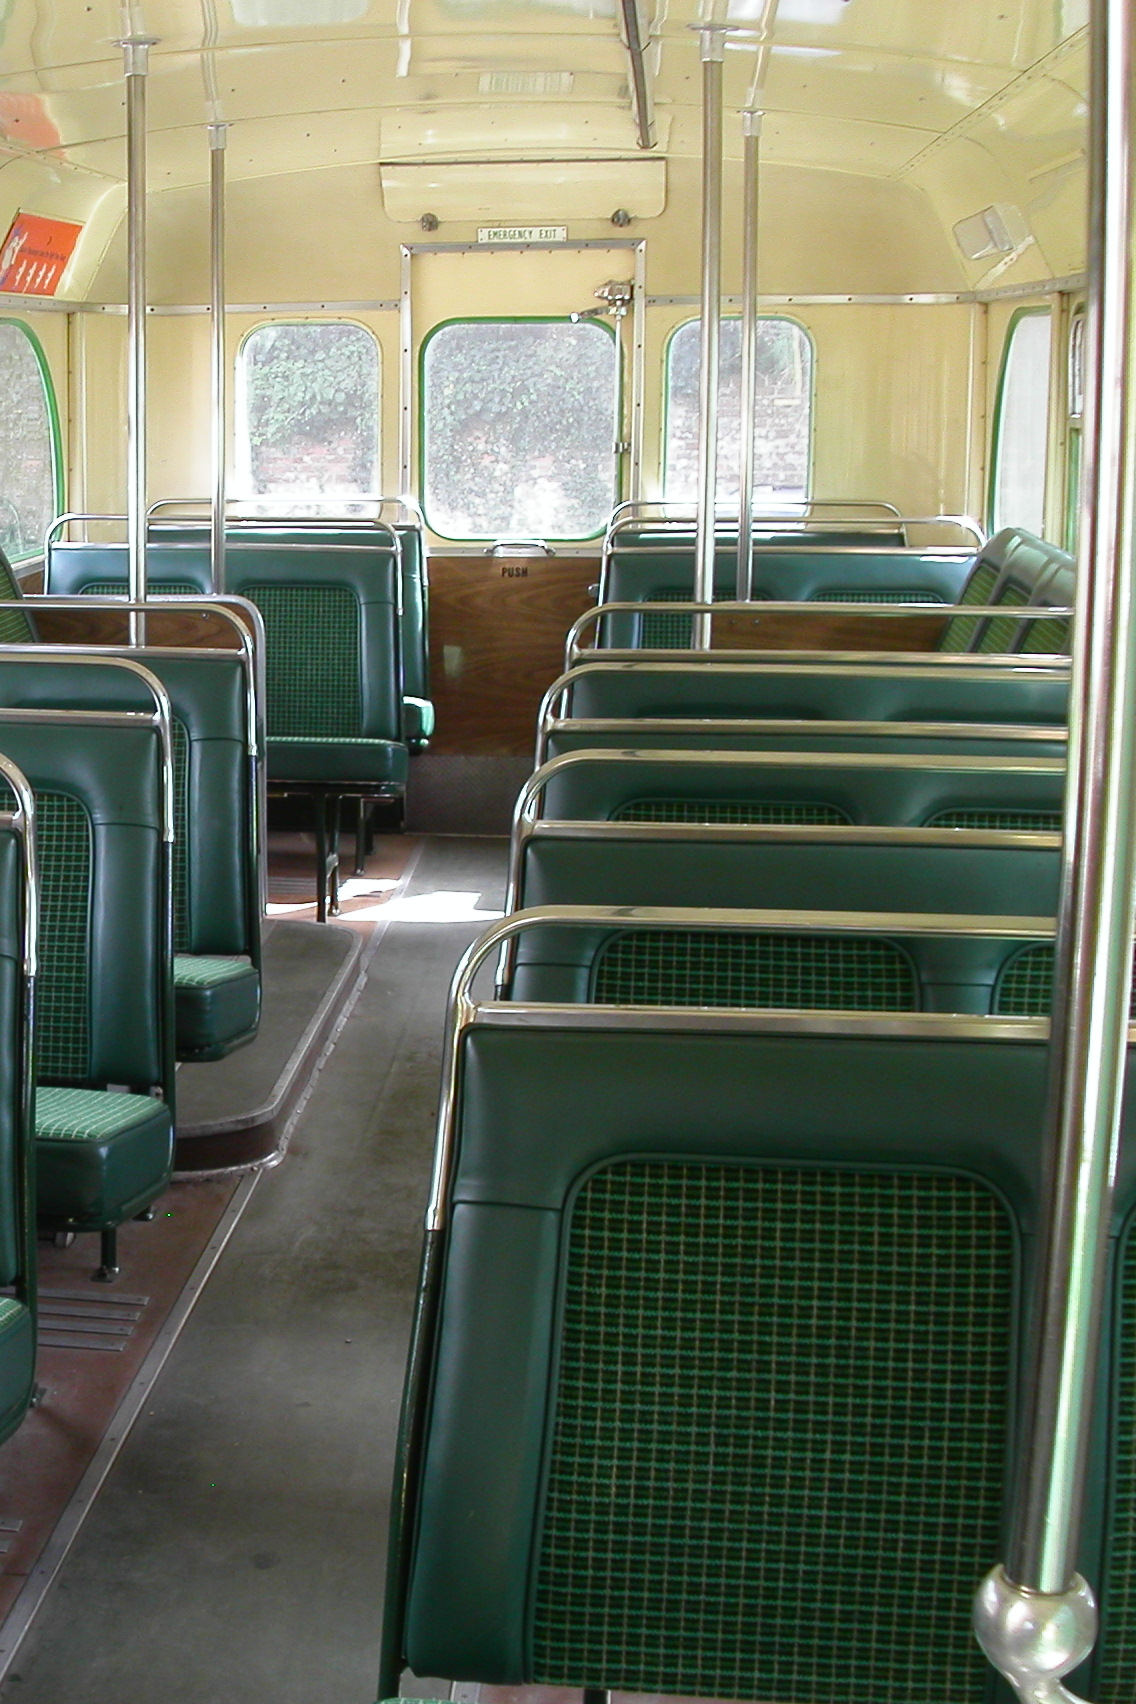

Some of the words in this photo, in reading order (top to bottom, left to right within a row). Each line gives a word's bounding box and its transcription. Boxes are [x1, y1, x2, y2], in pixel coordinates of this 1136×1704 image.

[488, 229, 533, 240] EMERGENCY
[540, 229, 556, 239] EXIT
[502, 567, 528, 577] PUSH
